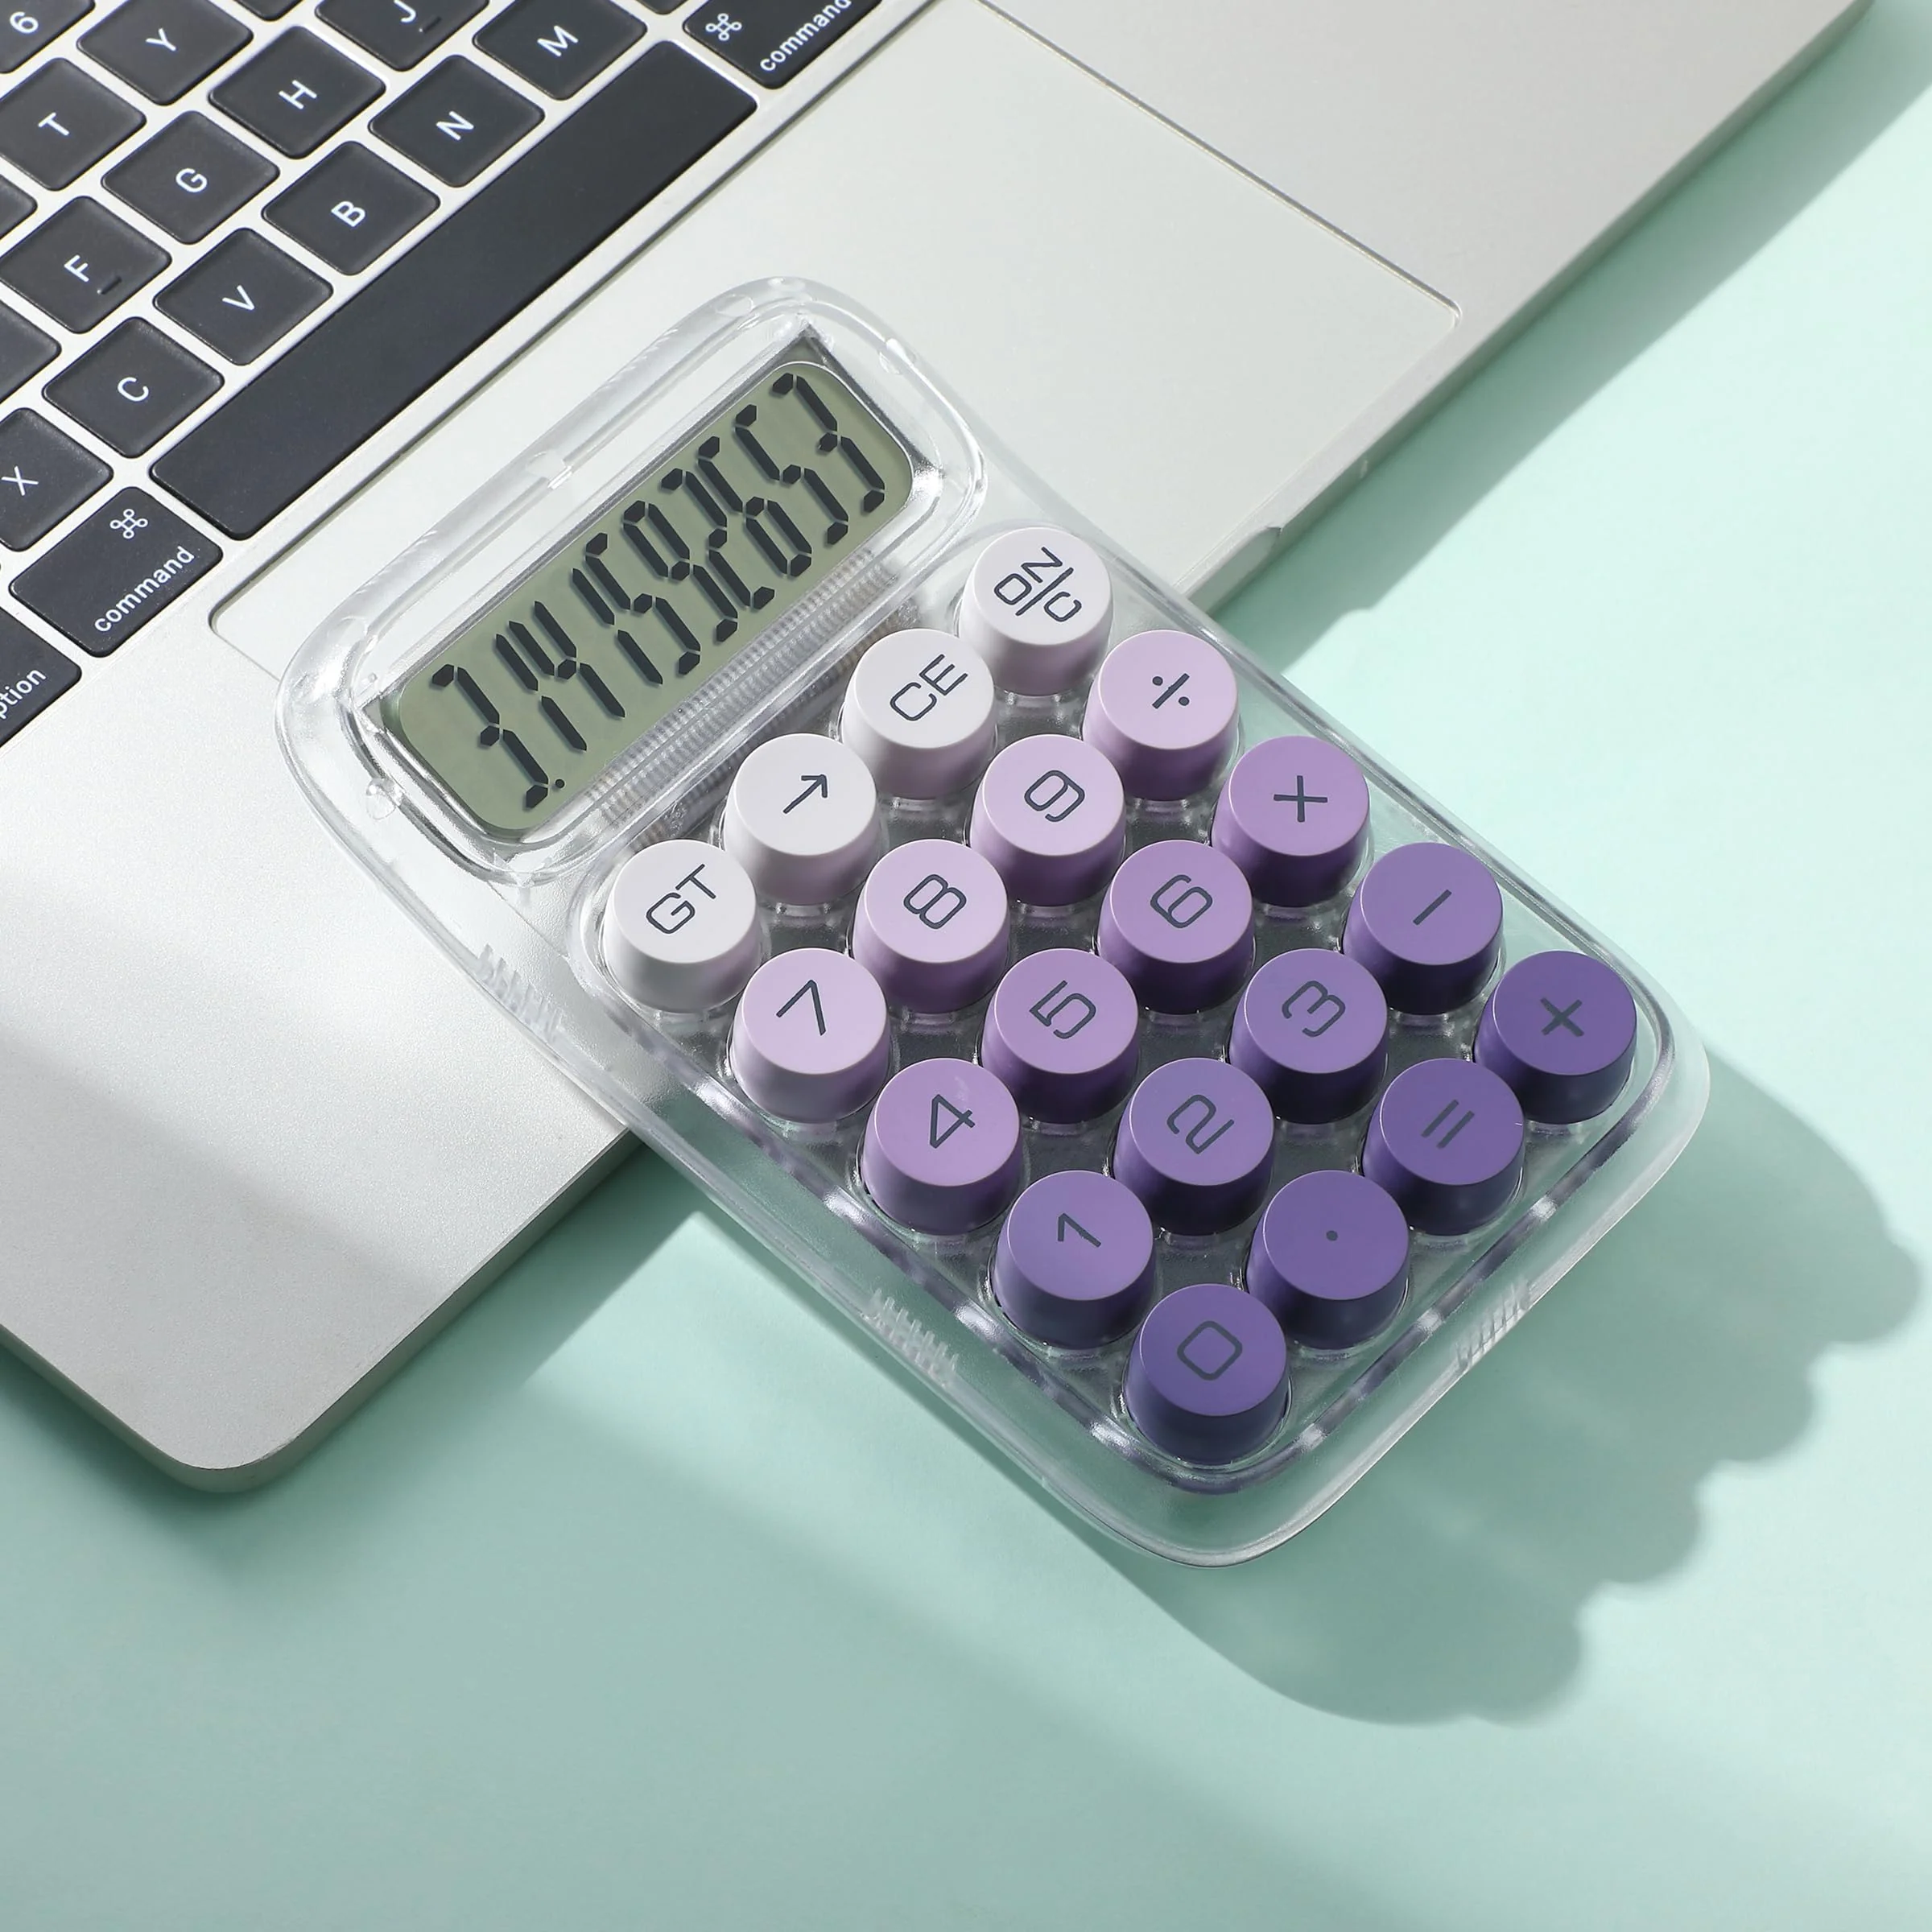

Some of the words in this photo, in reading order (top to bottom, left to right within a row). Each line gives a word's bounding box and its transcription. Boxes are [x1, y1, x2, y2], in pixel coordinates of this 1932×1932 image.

[10, 11, 39, 34] 6
[394, 0, 415, 23] J
[146, 28, 176, 52] Y
[538, 26, 578, 56] M
[761, 0, 852, 71] command
[279, 80, 316, 109] H
[39, 113, 69, 136] T
[436, 111, 473, 140] N
[175, 168, 208, 192] G
[332, 201, 365, 227] B
[64, 255, 89, 282] F
[222, 286, 255, 312] V
[118, 377, 148, 402] C
[2, 466, 39, 496] X
[95, 546, 194, 631] command
[432, 374, 885, 808] 3.141592653
[890, 654, 968, 721] CE
[1024, 770, 1085, 822] 9
[646, 864, 716, 934] GT
[903, 874, 967, 929] 8
[1150, 875, 1212, 928] 6
[776, 980, 826, 1035] 7
[1029, 980, 1096, 1039] 5
[1282, 980, 1345, 1037] 3
[930, 1094, 975, 1149] 4
[1166, 1095, 1234, 1154] 2
[1058, 1213, 1101, 1247] 1
[1177, 1321, 1242, 1381] 0
